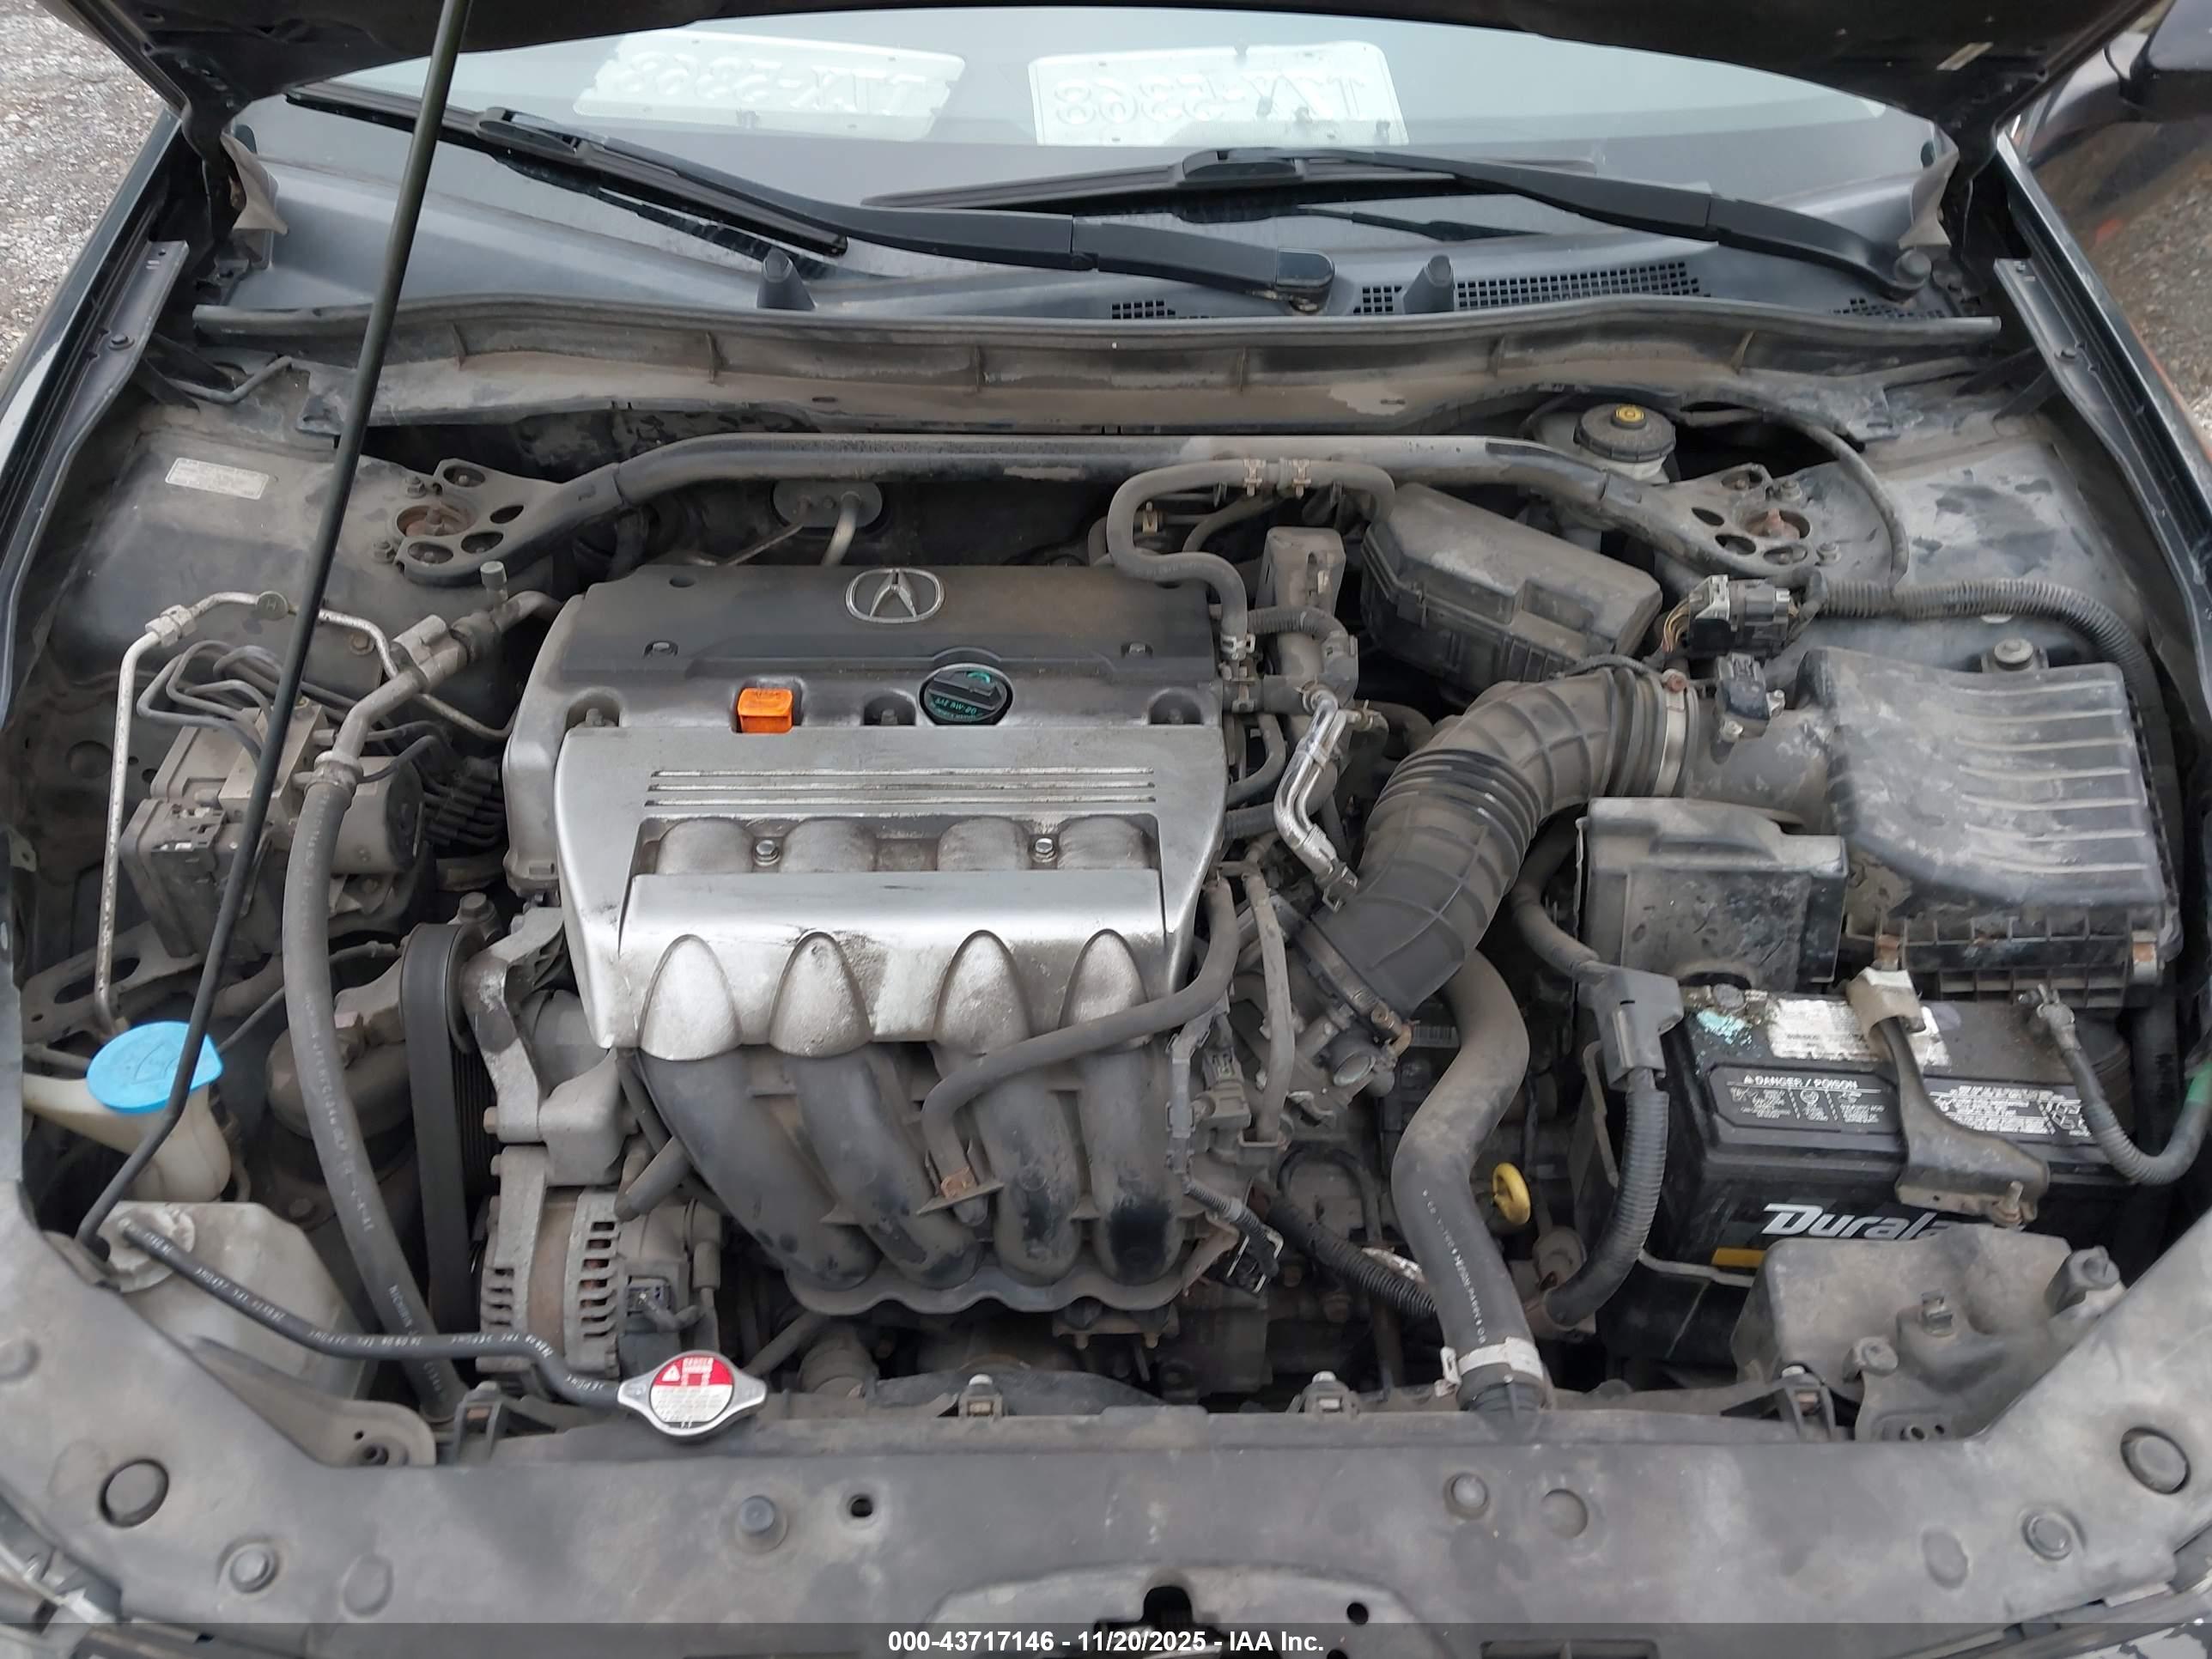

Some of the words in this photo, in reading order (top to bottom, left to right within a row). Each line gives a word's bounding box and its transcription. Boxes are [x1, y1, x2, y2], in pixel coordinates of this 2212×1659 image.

[1754, 1075, 1803, 1087] DANGER
[1813, 1079, 1858, 1090] POISON
[1760, 1202, 1953, 1241] Durala
